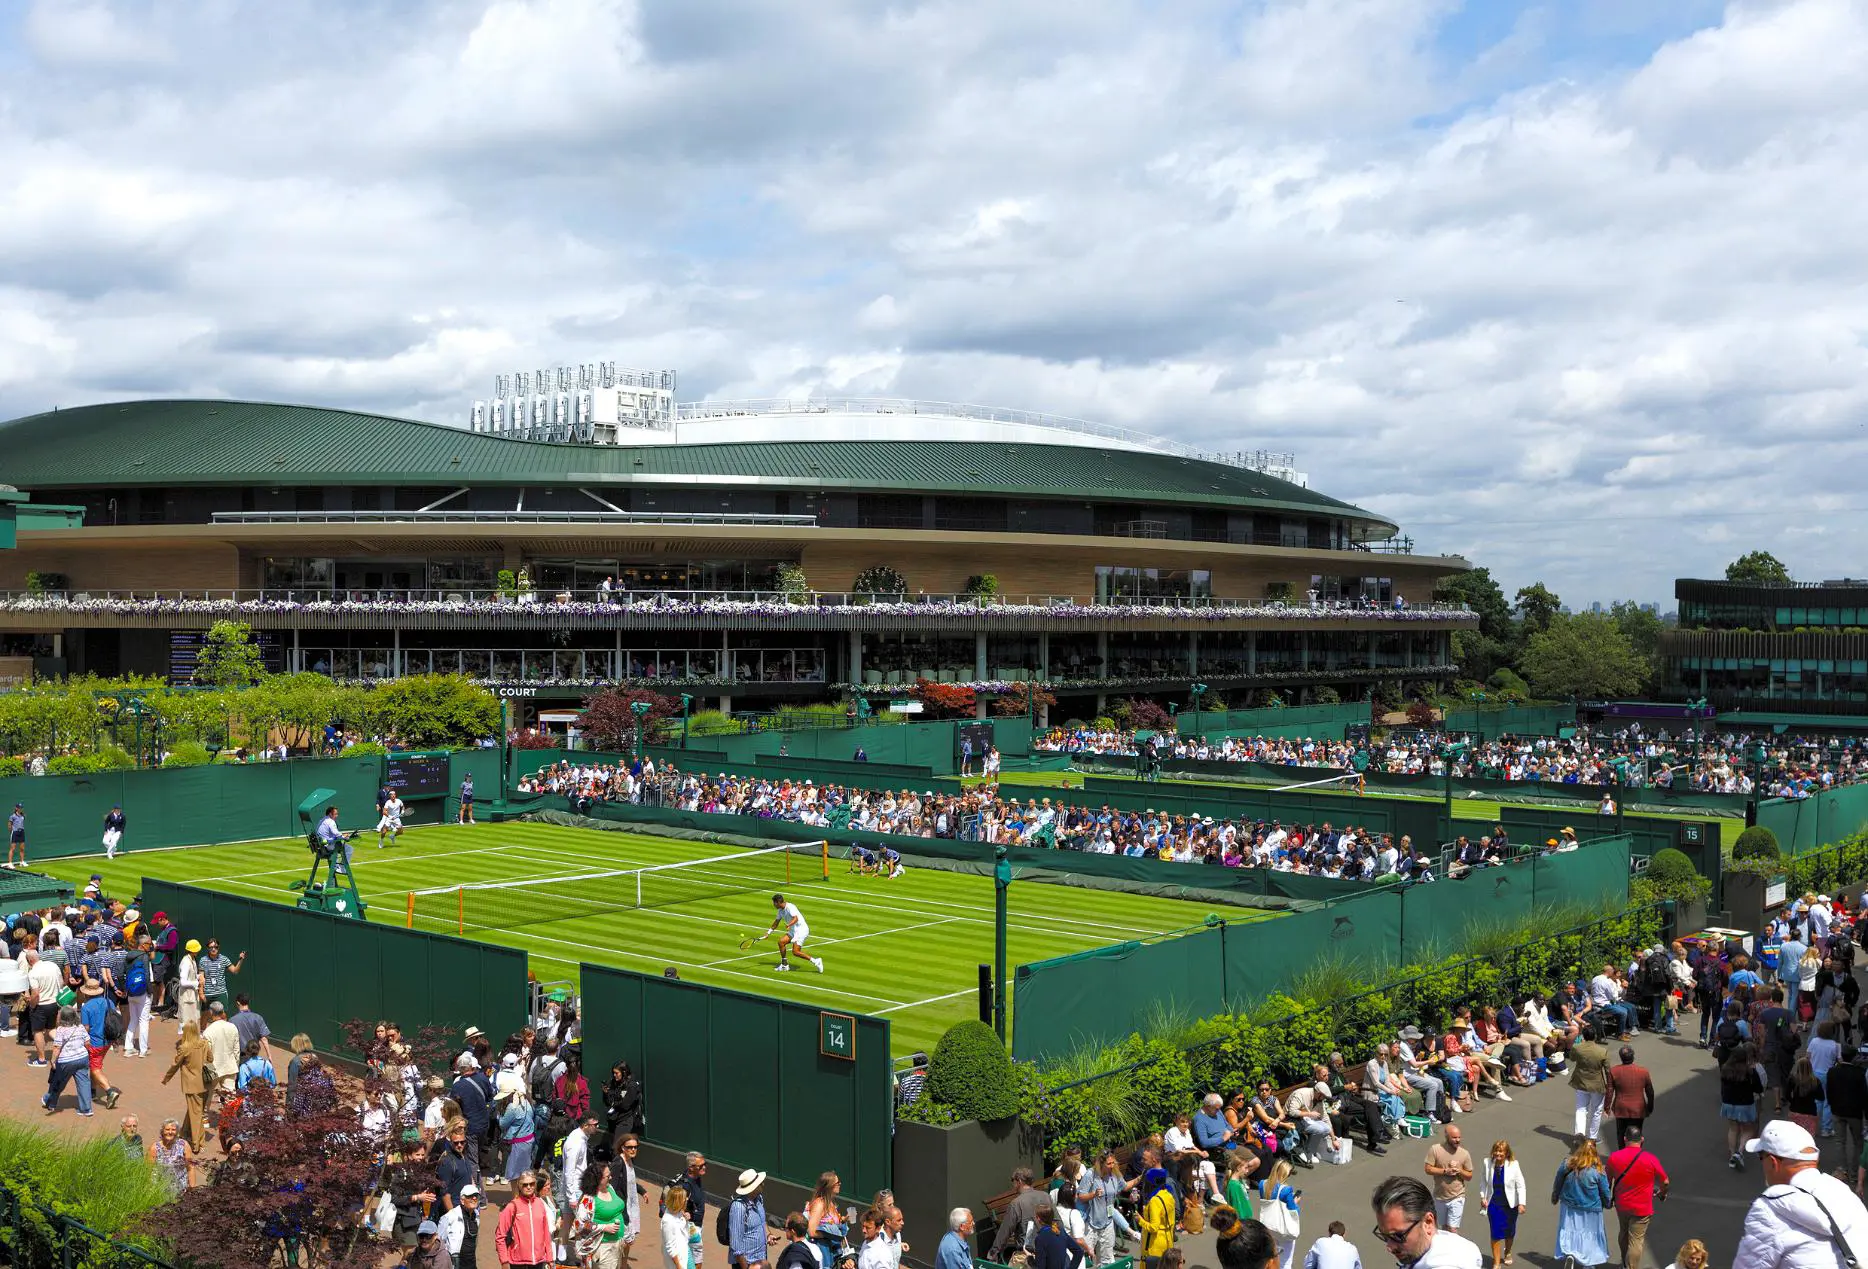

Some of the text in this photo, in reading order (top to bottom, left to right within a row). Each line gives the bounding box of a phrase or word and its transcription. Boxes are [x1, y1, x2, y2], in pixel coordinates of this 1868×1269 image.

[499, 688, 537, 697] COURT
[524, 705, 536, 722] 2
[1686, 830, 1698, 840] 15
[828, 1031, 845, 1049] 14
